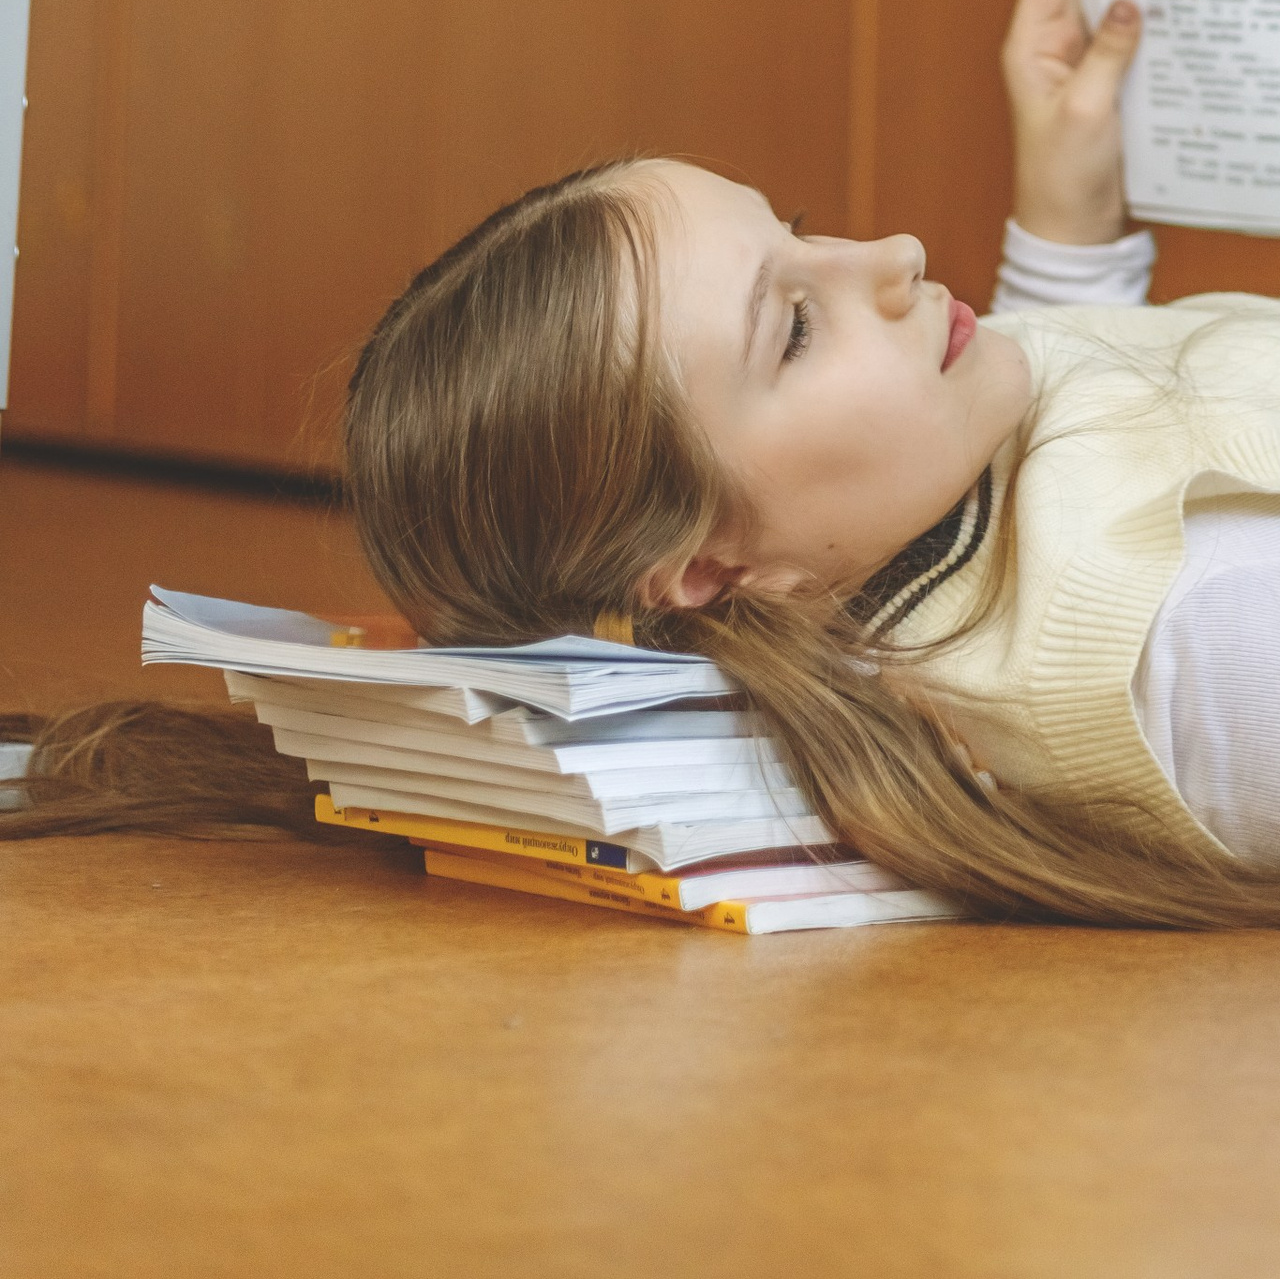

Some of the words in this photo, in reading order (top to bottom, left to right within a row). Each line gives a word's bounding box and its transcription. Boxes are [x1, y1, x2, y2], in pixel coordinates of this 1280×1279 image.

[505, 832, 520, 845] мир
[522, 837, 578, 857] Окружающий
[724, 912, 735, 925] 4
